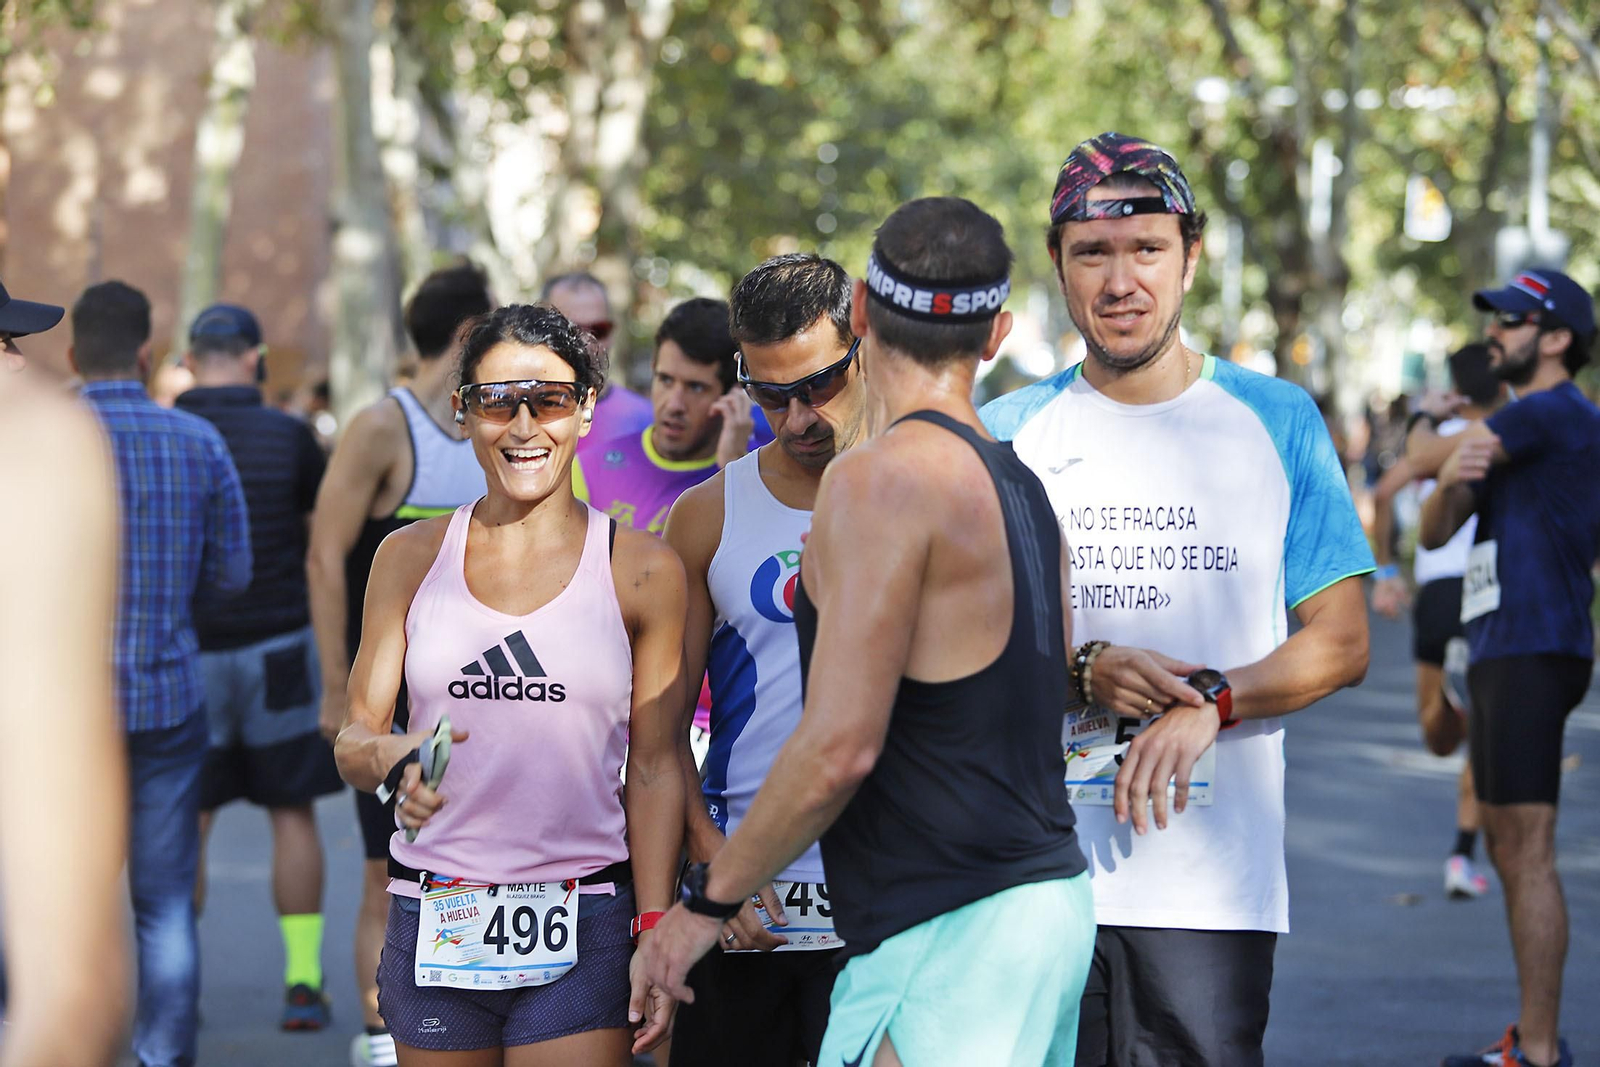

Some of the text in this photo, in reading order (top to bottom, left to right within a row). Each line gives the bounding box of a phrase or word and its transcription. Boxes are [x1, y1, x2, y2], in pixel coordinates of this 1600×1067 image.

[1070, 507, 1095, 531] NO
[1101, 507, 1117, 531] SE
[1123, 506, 1198, 531] FRACASA
[1069, 545, 1239, 574] ASTA QUE NO SE DEJA
[447, 674, 567, 703] adidas
[507, 882, 546, 892] MAYTE
[433, 893, 477, 911] 35 VUELTA
[440, 912, 447, 924] A
[447, 906, 480, 922] HUELVA
[483, 905, 569, 956] 496
